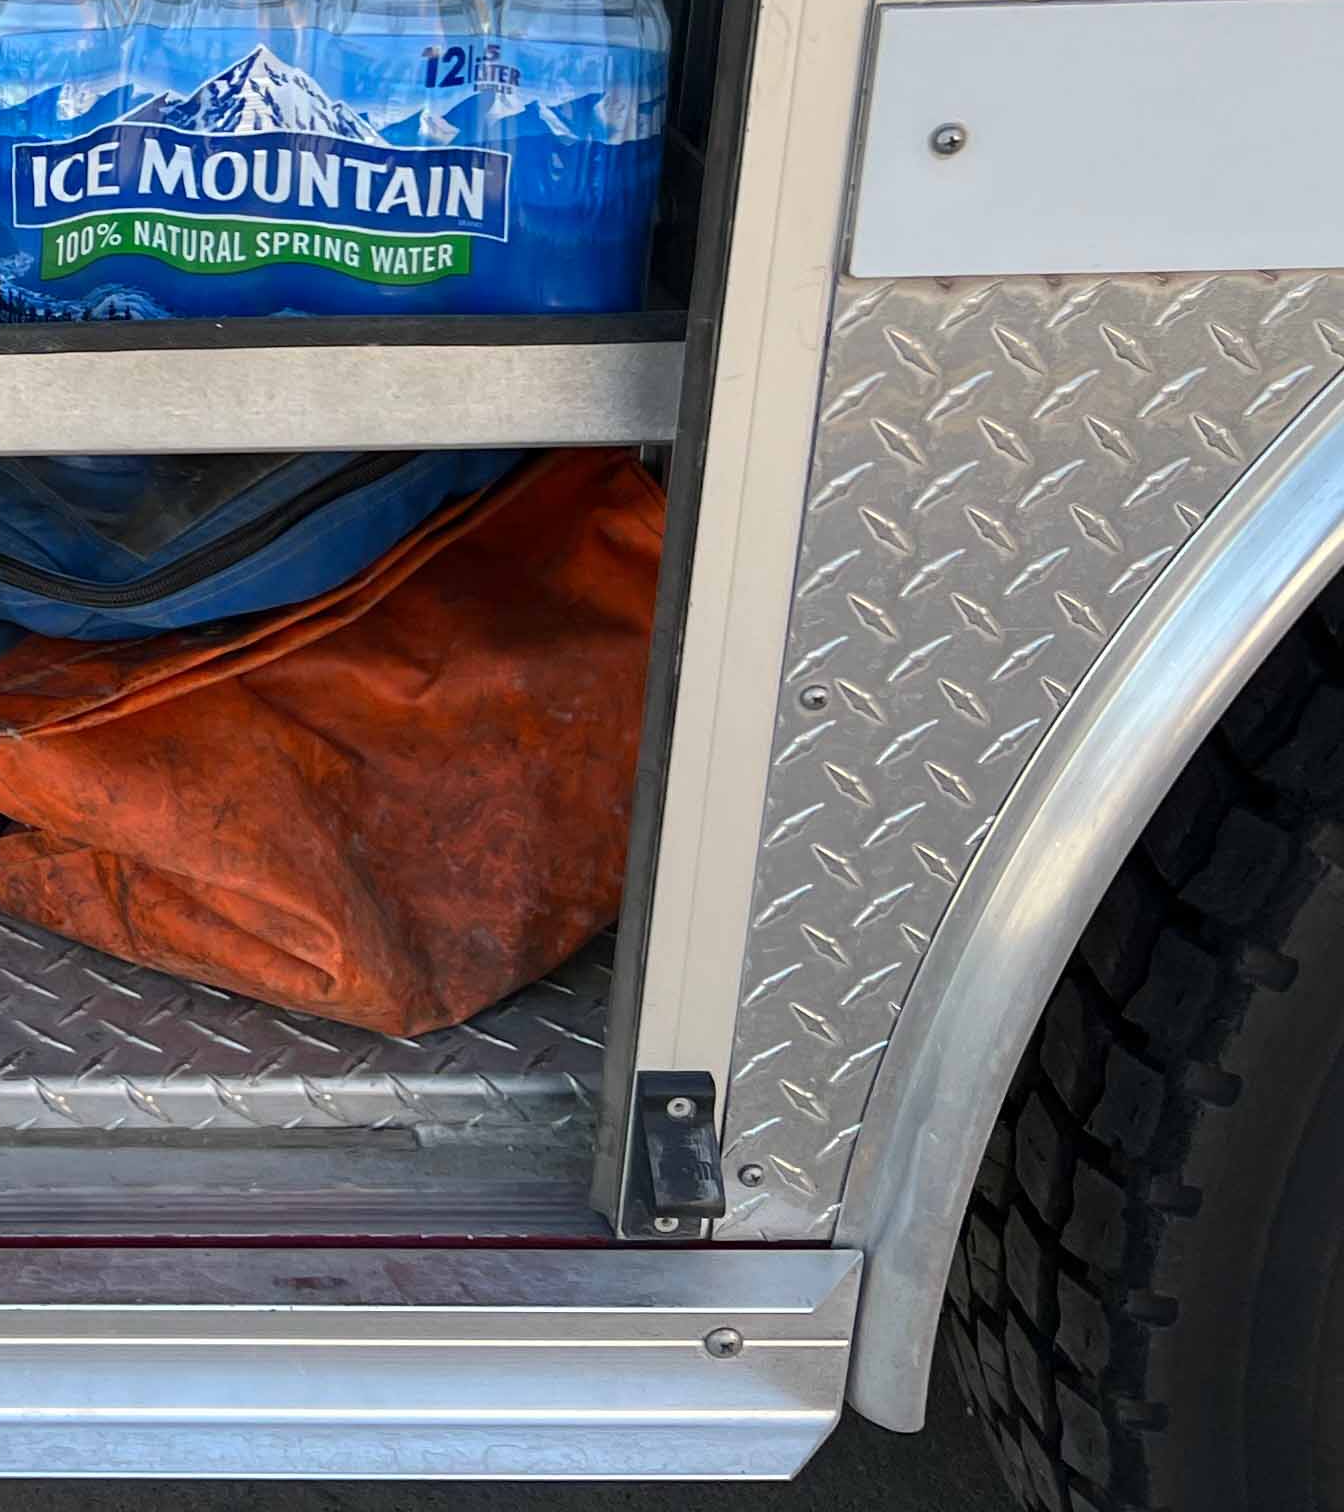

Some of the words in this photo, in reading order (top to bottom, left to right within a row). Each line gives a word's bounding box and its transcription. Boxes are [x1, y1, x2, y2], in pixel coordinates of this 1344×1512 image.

[421, 46, 466, 88] 12
[32, 141, 121, 207] ICE
[137, 138, 486, 220] MOUNTAIN
[55, 221, 122, 266] 100%
[133, 220, 247, 264] NATURAL
[255, 231, 360, 268] SPRING
[369, 243, 455, 276] WATER
